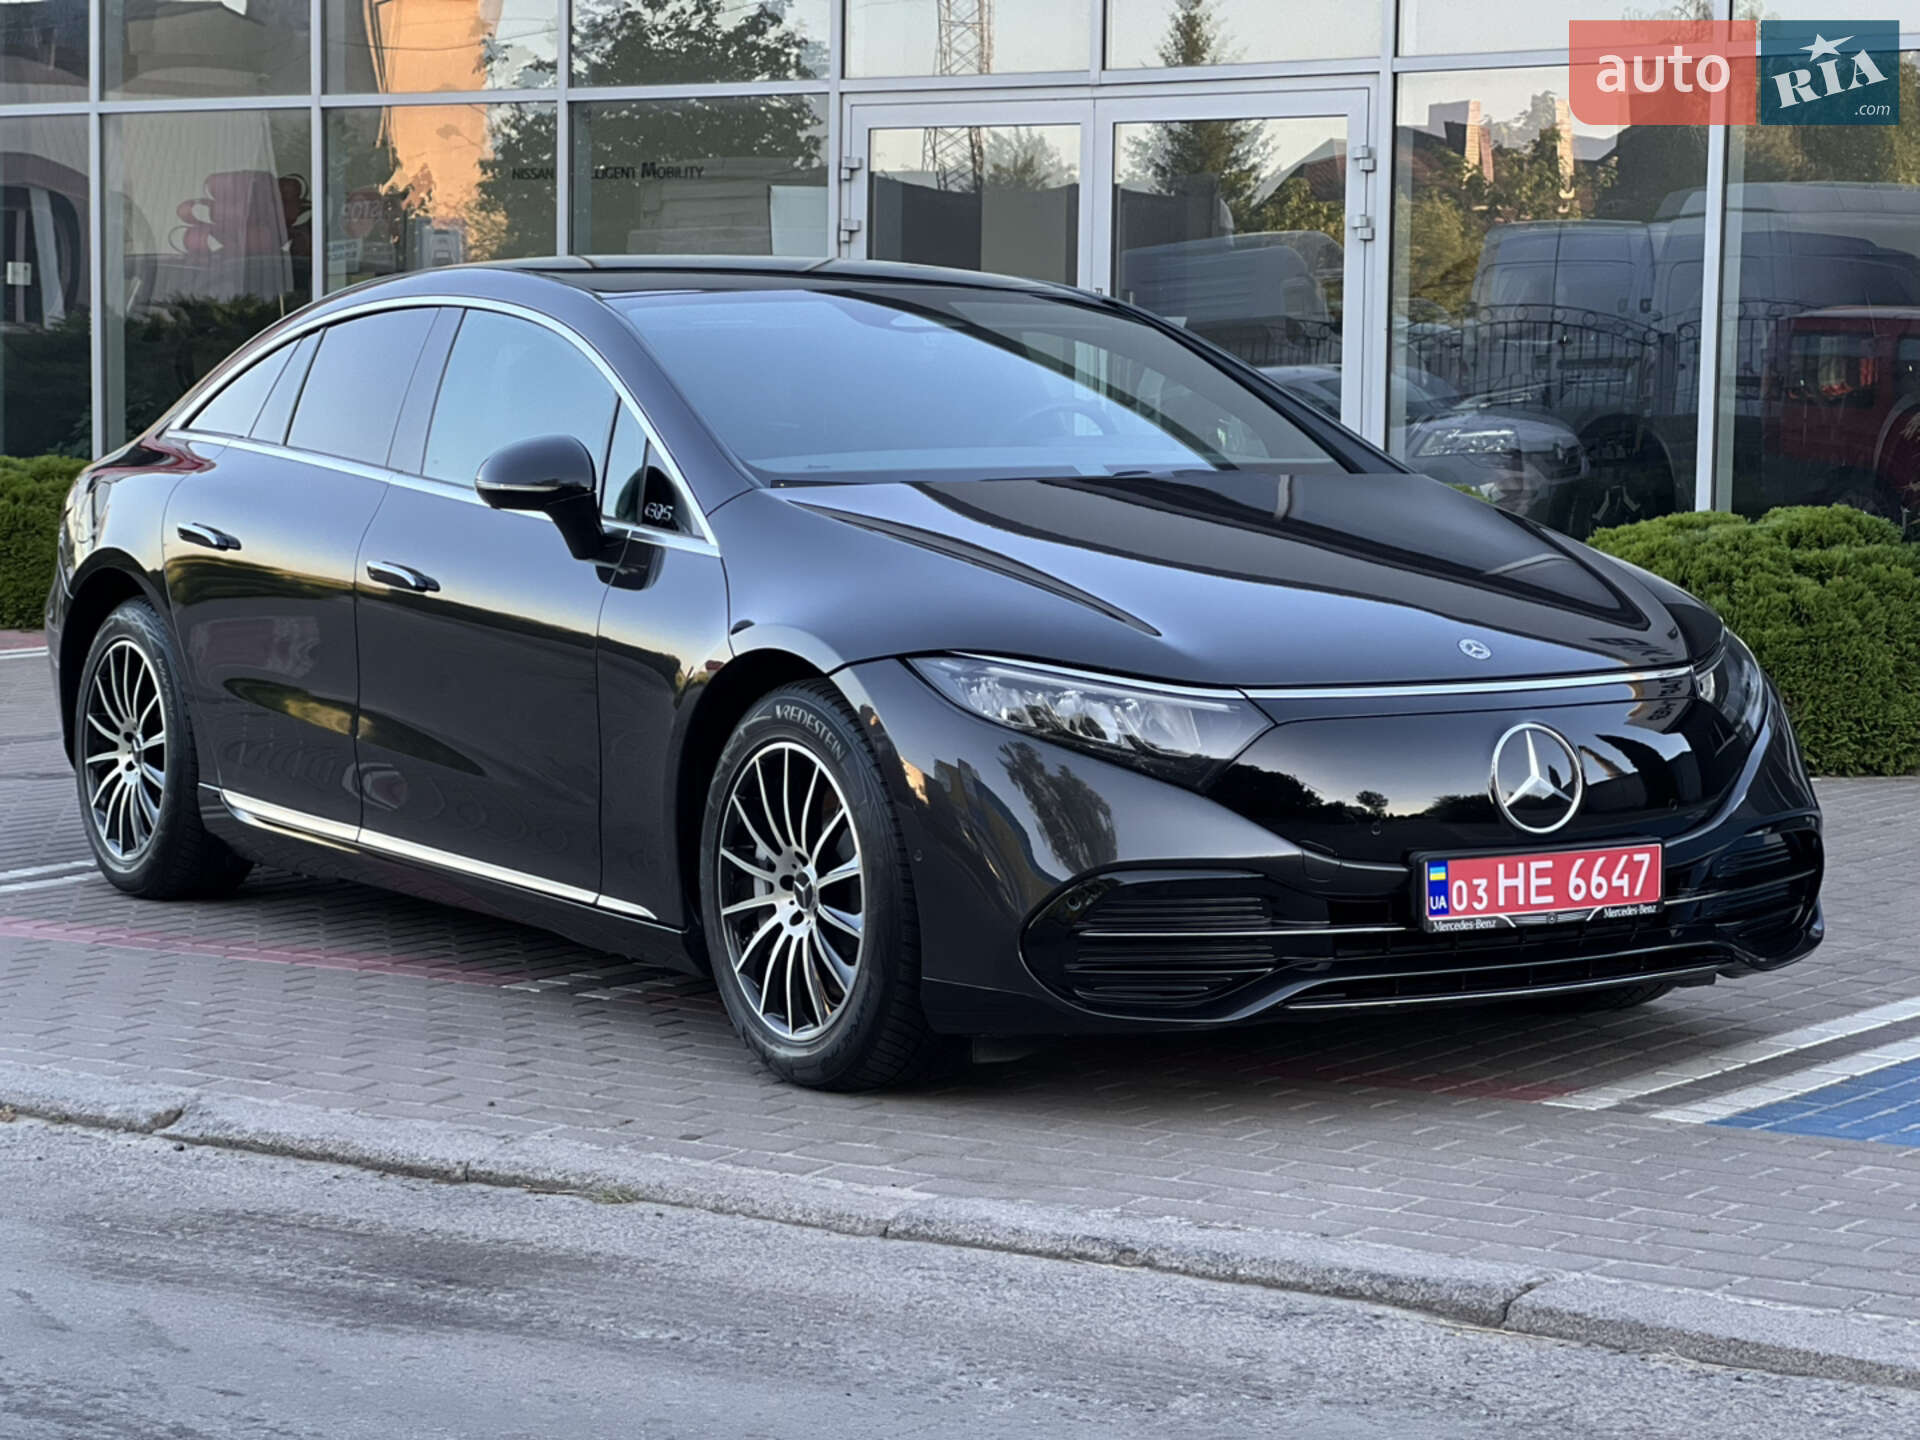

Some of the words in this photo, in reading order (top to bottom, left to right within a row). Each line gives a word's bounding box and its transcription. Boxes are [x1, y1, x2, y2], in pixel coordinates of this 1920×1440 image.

[511, 167, 554, 180] NISSAN
[775, 704, 846, 761] VREDESTEIN
[1452, 878, 1488, 912] 03
[1498, 860, 1554, 907] HE
[1568, 853, 1651, 901] 6647
[1430, 896, 1447, 910] UA
[1603, 904, 1657, 919] Mercedes-Benz
[1433, 919, 1497, 932] Mercedes-Benz
